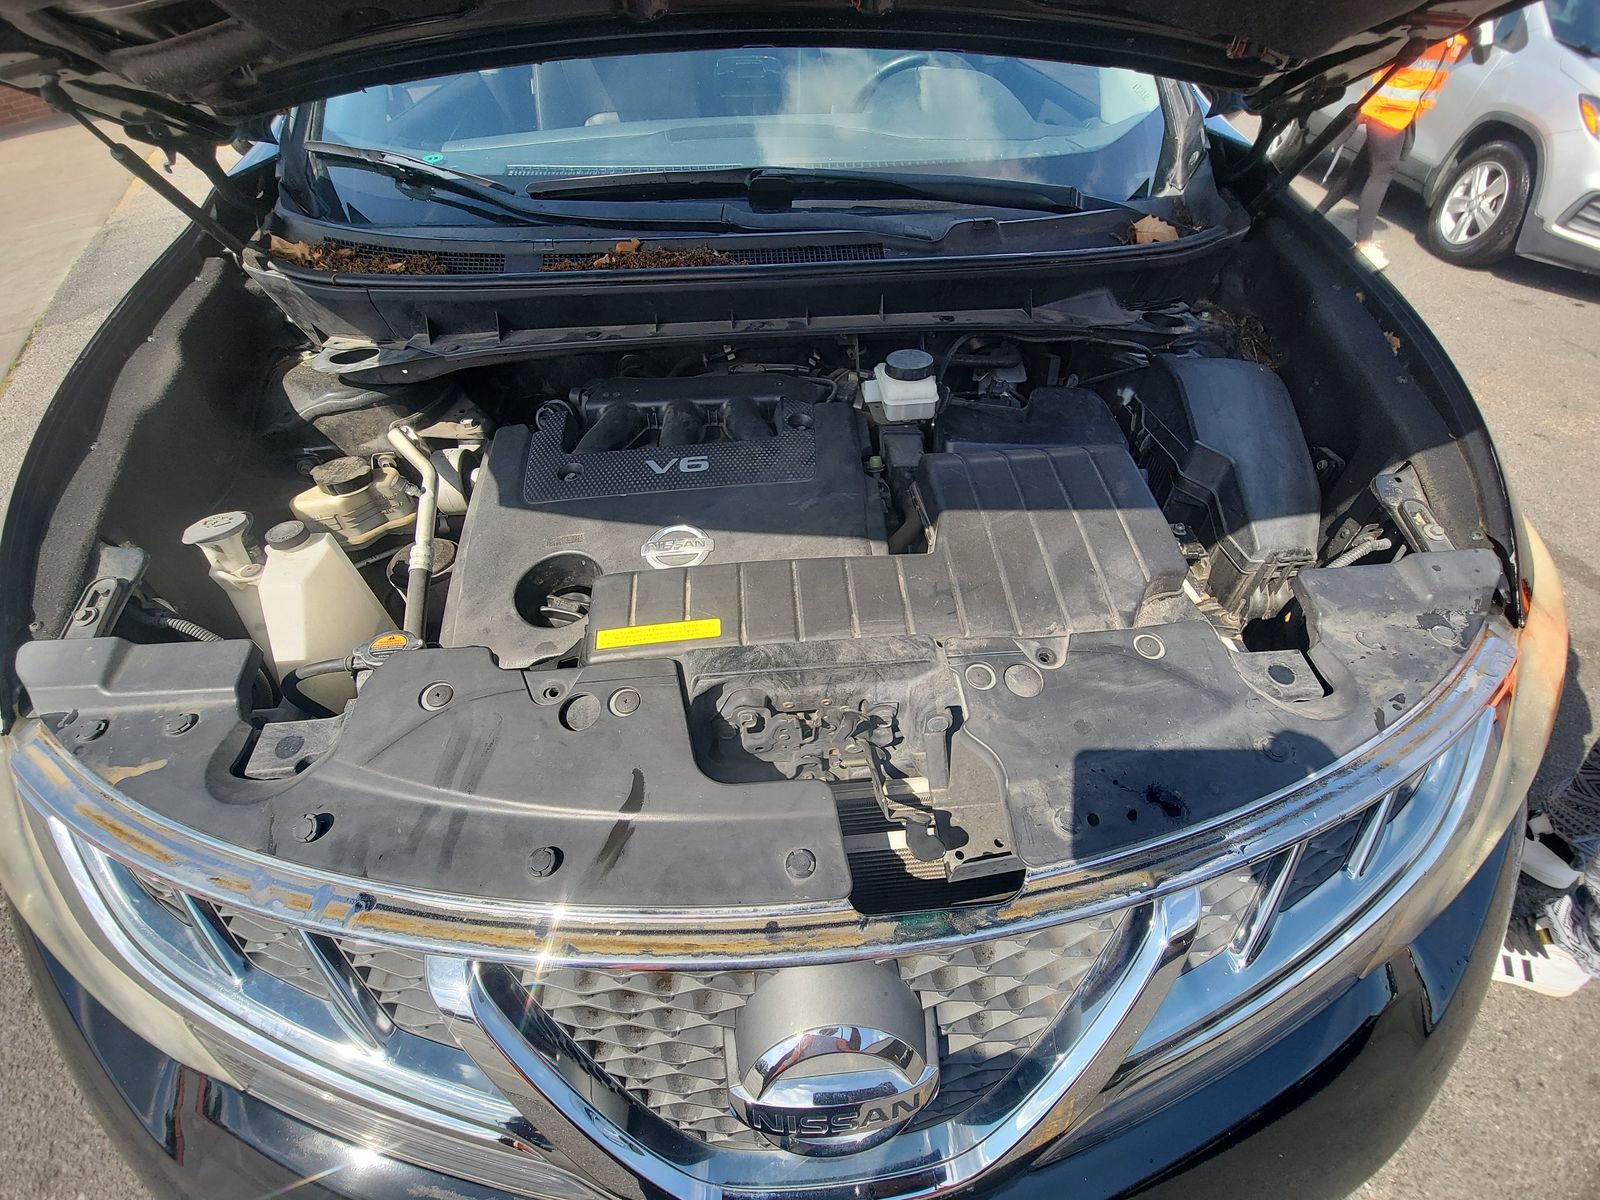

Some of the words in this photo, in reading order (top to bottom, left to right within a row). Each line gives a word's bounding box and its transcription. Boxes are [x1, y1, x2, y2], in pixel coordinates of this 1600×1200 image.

[645, 456, 710, 474] V6
[644, 539, 706, 552] NISSAN
[752, 1092, 920, 1135] NISSAN
